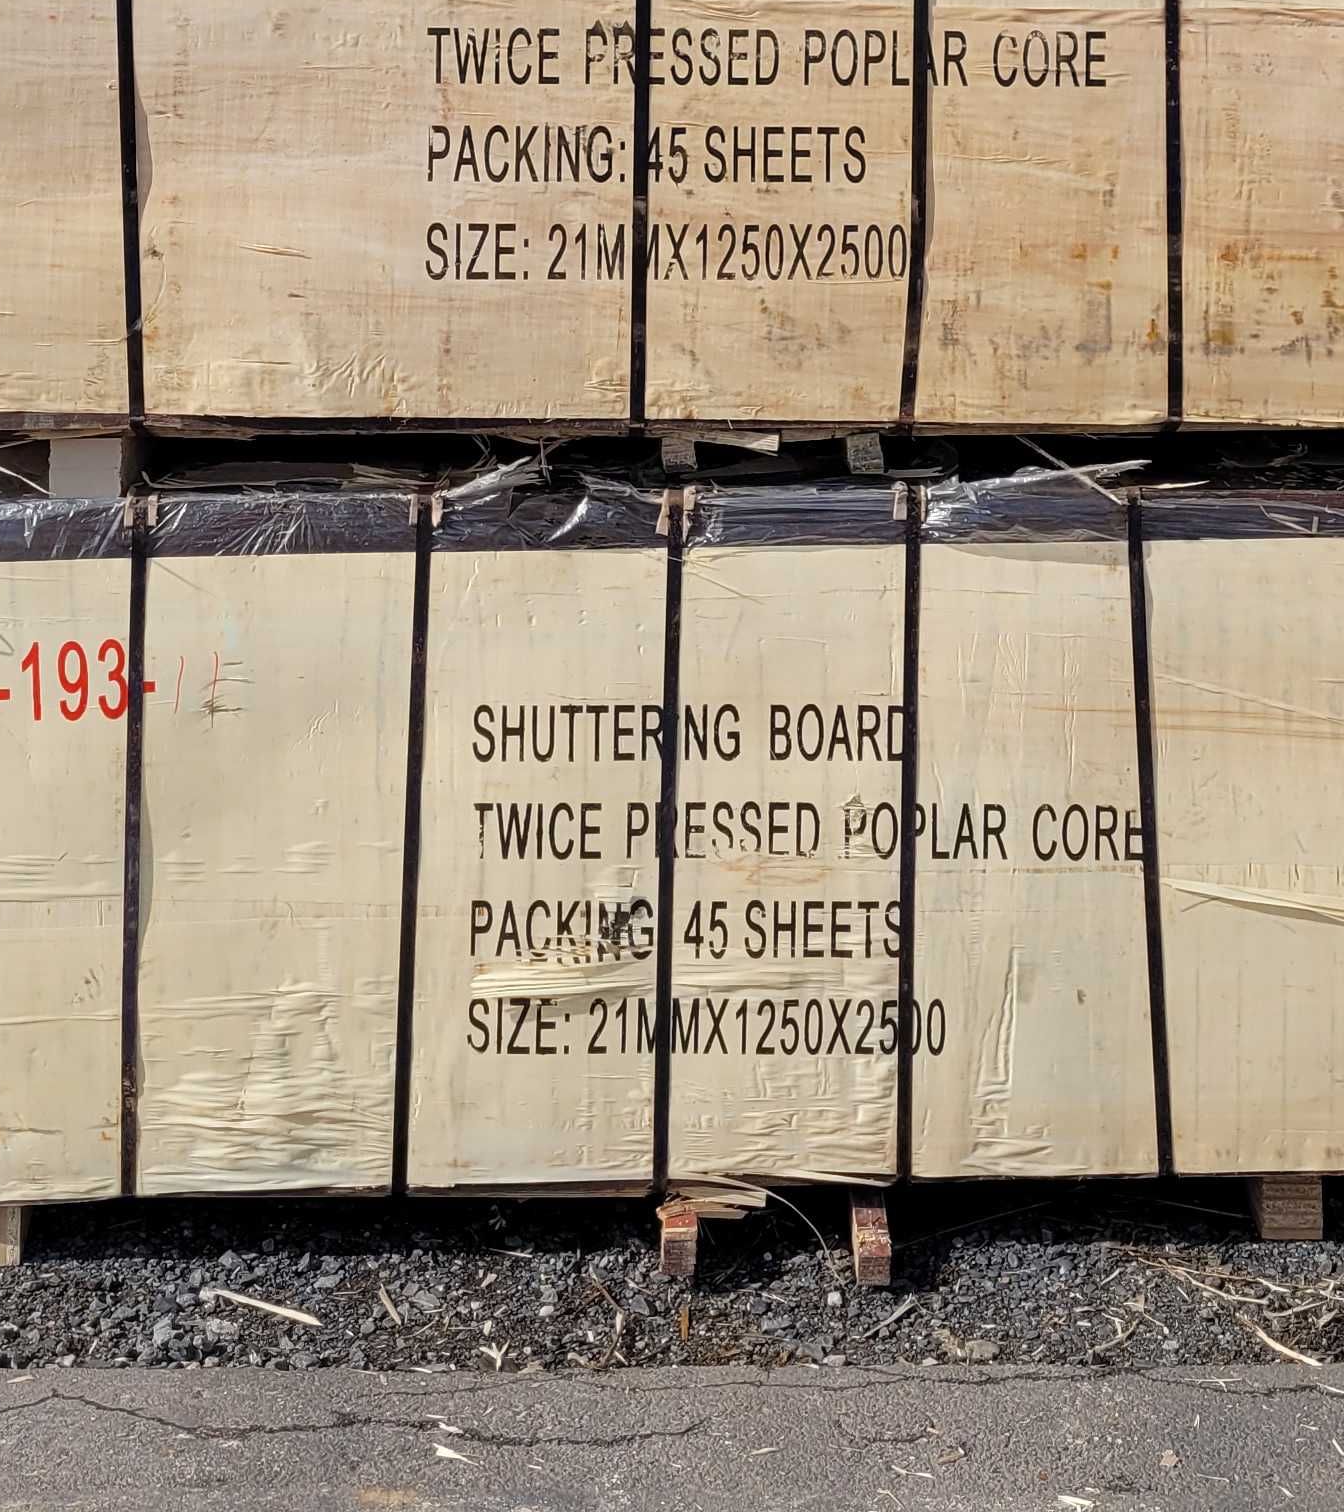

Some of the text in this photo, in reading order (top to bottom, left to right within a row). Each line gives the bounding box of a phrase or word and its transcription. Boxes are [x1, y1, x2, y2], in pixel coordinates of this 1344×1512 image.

[426, 27, 561, 86] TWICE
[992, 29, 1108, 88] CORE
[427, 124, 868, 185] PACKING: 45 SHEETS
[424, 222, 531, 281] SIZE:
[471, 703, 905, 763] SHUTTERNG BOARD
[473, 801, 603, 860] TWICE
[1032, 803, 1145, 862] CORE
[683, 900, 729, 960] 45
[743, 899, 903, 960] SHEETS
[466, 997, 571, 1055] SIZE:
